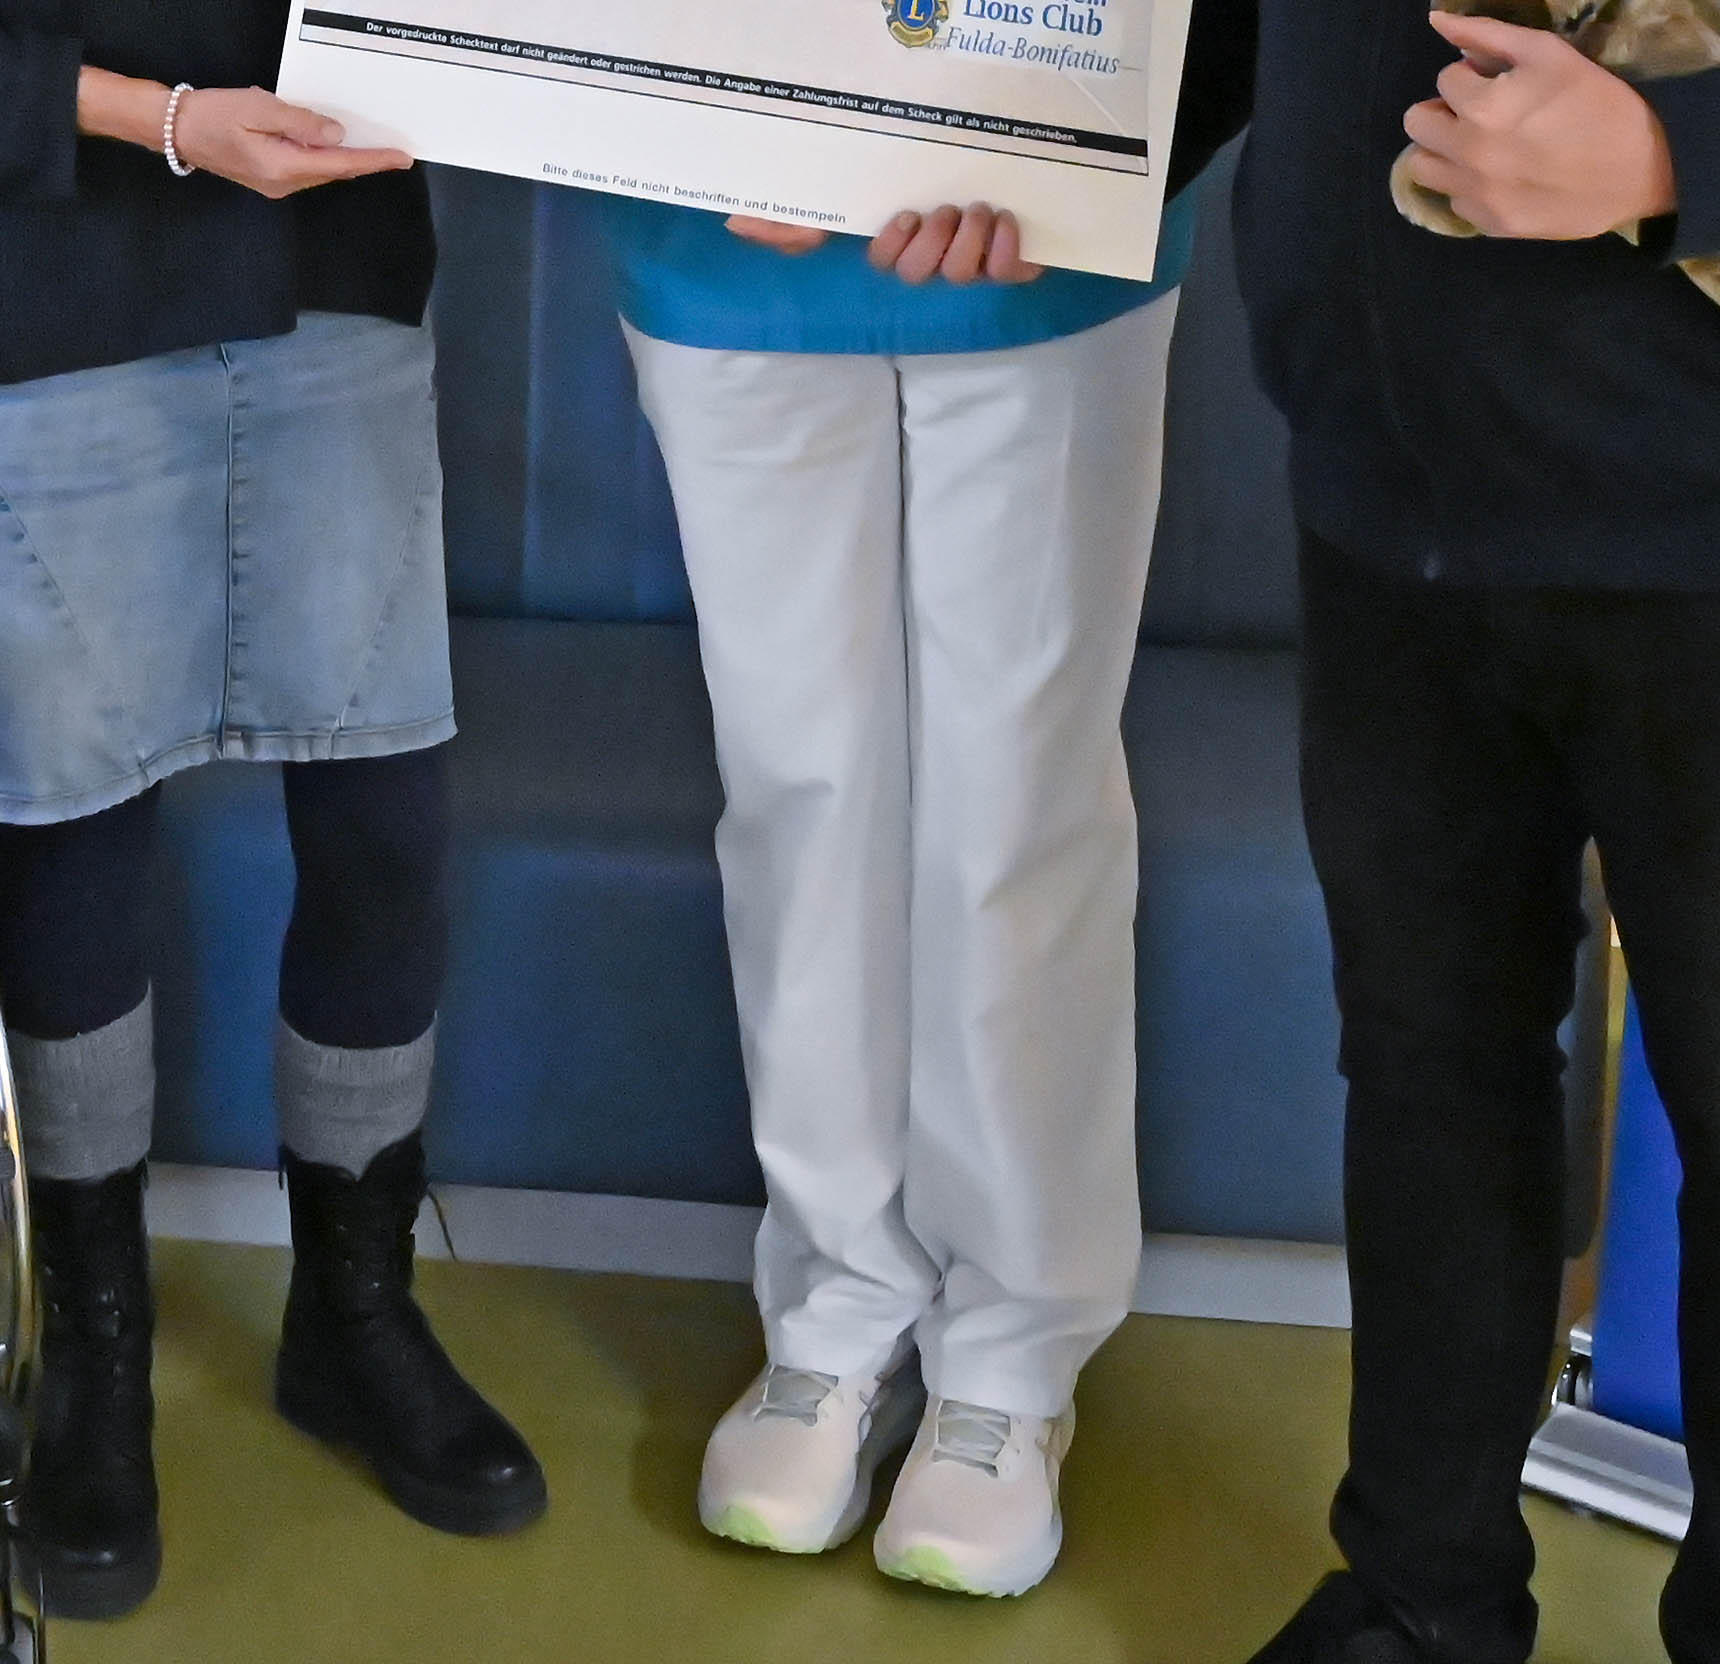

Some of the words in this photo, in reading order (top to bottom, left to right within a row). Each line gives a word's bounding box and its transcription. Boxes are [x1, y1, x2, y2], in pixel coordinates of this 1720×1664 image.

[1042, 3, 1103, 37] Club
[365, 21, 383, 33] Der
[386, 26, 447, 44] vorgedruckte
[449, 34, 499, 52] Schecktext
[500, 44, 521, 54] darf
[521, 46, 545, 58] nicht
[547, 51, 589, 66] geändert
[590, 57, 612, 69] oder
[613, 62, 662, 78] gestrichen
[704, 74, 721, 86] Die
[723, 77, 762, 93] Angabe
[764, 84, 791, 97] einer
[792, 88, 859, 109] Zahlungsfrist
[861, 100, 880, 112] auf
[881, 102, 905, 116] dem
[907, 107, 943, 122] Scheck
[945, 113, 964, 127] gilt
[965, 117, 981, 129] als
[983, 121, 1010, 133] nicht
[946, 26, 1121, 75] Fulda-Bonifatius
[542, 162, 569, 177] Bitte
[572, 168, 609, 185] dieses
[612, 175, 638, 189] Feld
[641, 180, 670, 196] nicht
[674, 186, 740, 207] beschriften
[743, 197, 768, 212] und
[772, 202, 847, 225] bestempeln
